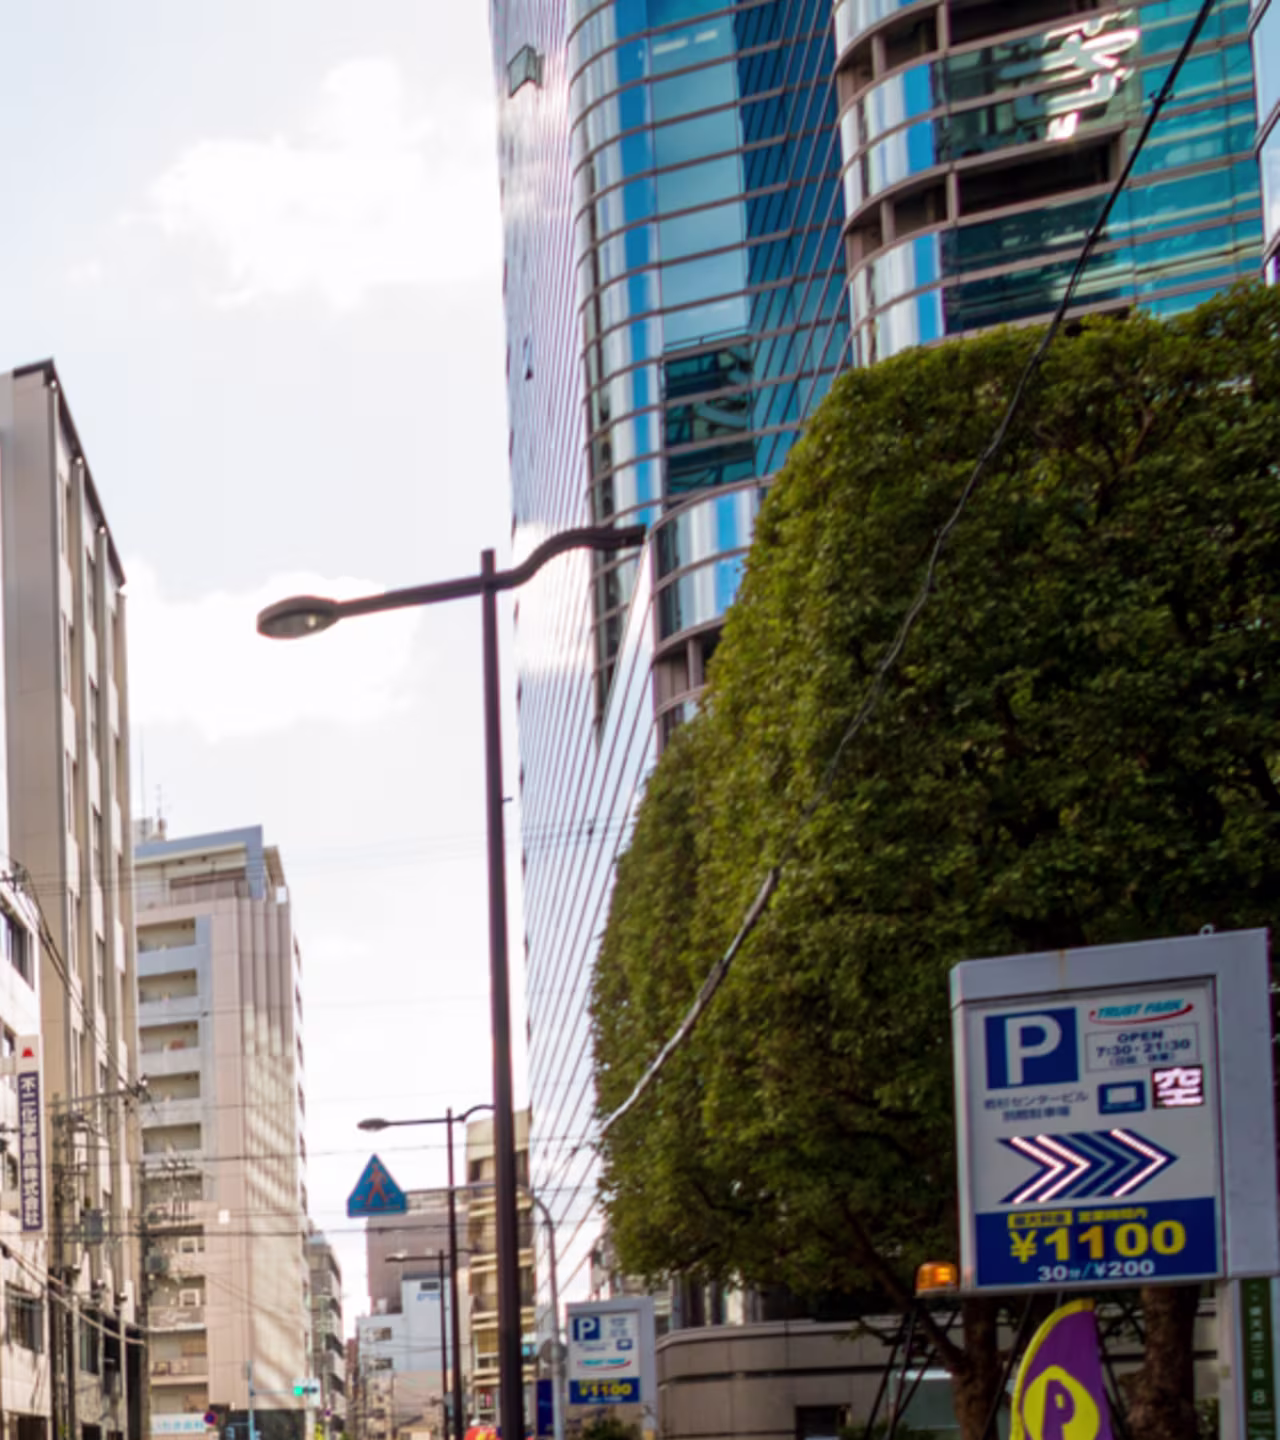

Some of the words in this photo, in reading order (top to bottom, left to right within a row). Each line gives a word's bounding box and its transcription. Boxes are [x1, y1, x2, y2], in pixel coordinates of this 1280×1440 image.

[1006, 1014, 1062, 1086] P
[1117, 1030, 1163, 1043] OPEN
[1154, 1067, 1203, 1107] 空
[1009, 1220, 1186, 1263] ¥1100
